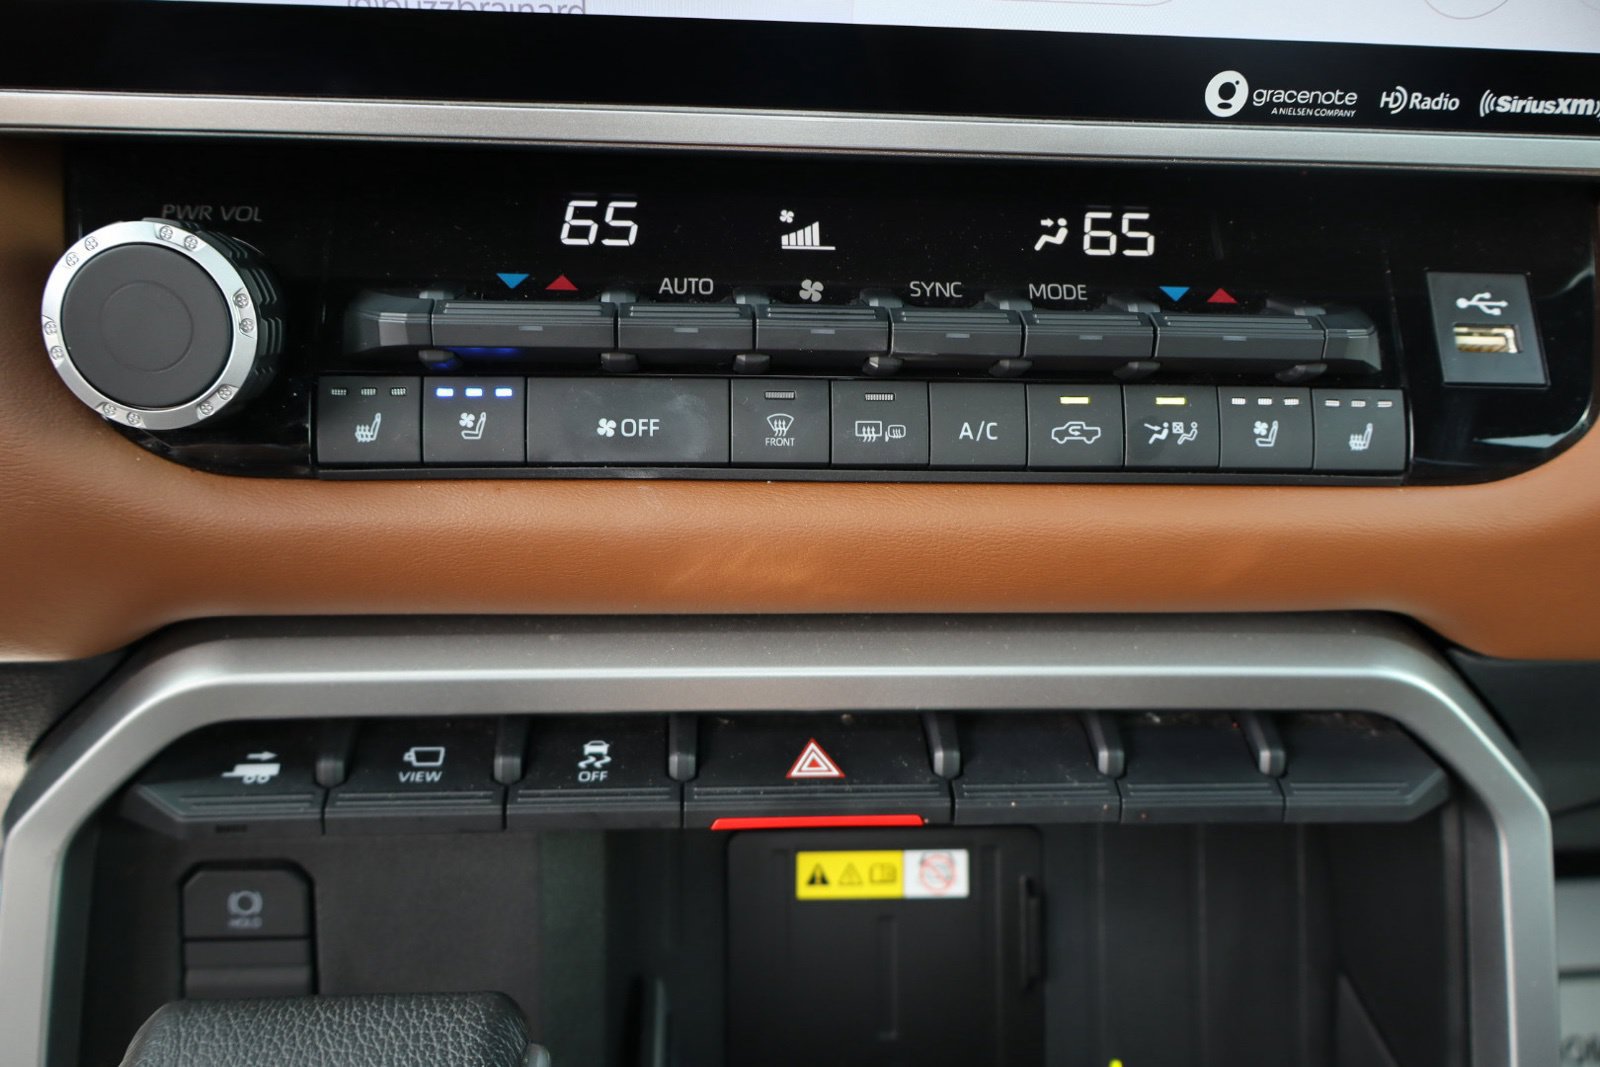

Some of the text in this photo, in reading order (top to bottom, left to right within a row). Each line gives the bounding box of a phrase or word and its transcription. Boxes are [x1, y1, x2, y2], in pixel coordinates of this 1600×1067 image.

[1252, 88, 1358, 107] gracenote
[1380, 85, 1460, 115] HD Radio
[1270, 107, 1357, 118] A NIELSEN COMPANY
[161, 203, 263, 222] PWR VOL
[560, 200, 639, 247] 65
[1082, 212, 1155, 257] 65
[658, 277, 714, 295] AUTO
[909, 281, 964, 298] SYNC
[1028, 283, 1088, 301] MODE
[620, 418, 661, 438] OFF
[958, 421, 998, 442] A/C
[765, 437, 795, 447] FRONT
[398, 770, 443, 783] VIEW
[578, 770, 608, 783] OFF
